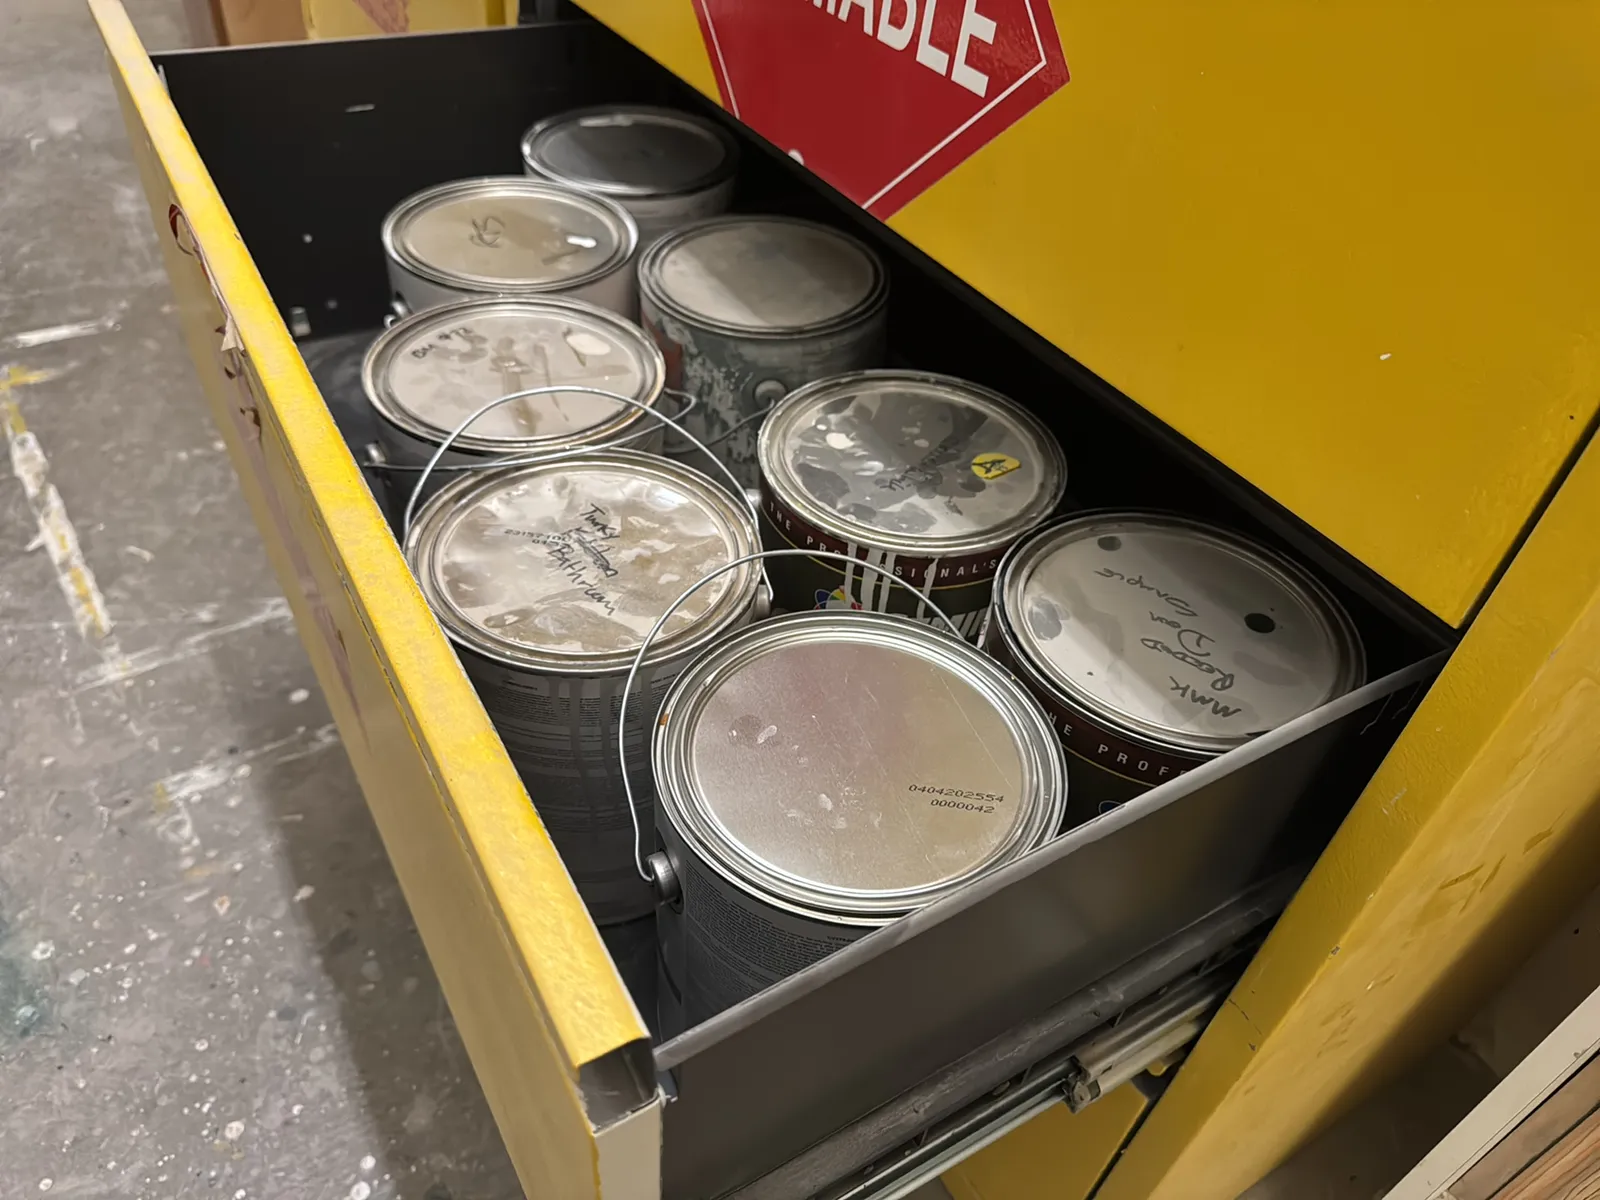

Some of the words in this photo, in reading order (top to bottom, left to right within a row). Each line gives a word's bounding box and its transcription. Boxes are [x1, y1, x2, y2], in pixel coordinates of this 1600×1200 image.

[769, 500, 792, 532] THE
[1169, 675, 1242, 718] MMK
[908, 784, 1004, 803] 0404202554
[930, 799, 995, 814] 0000042
